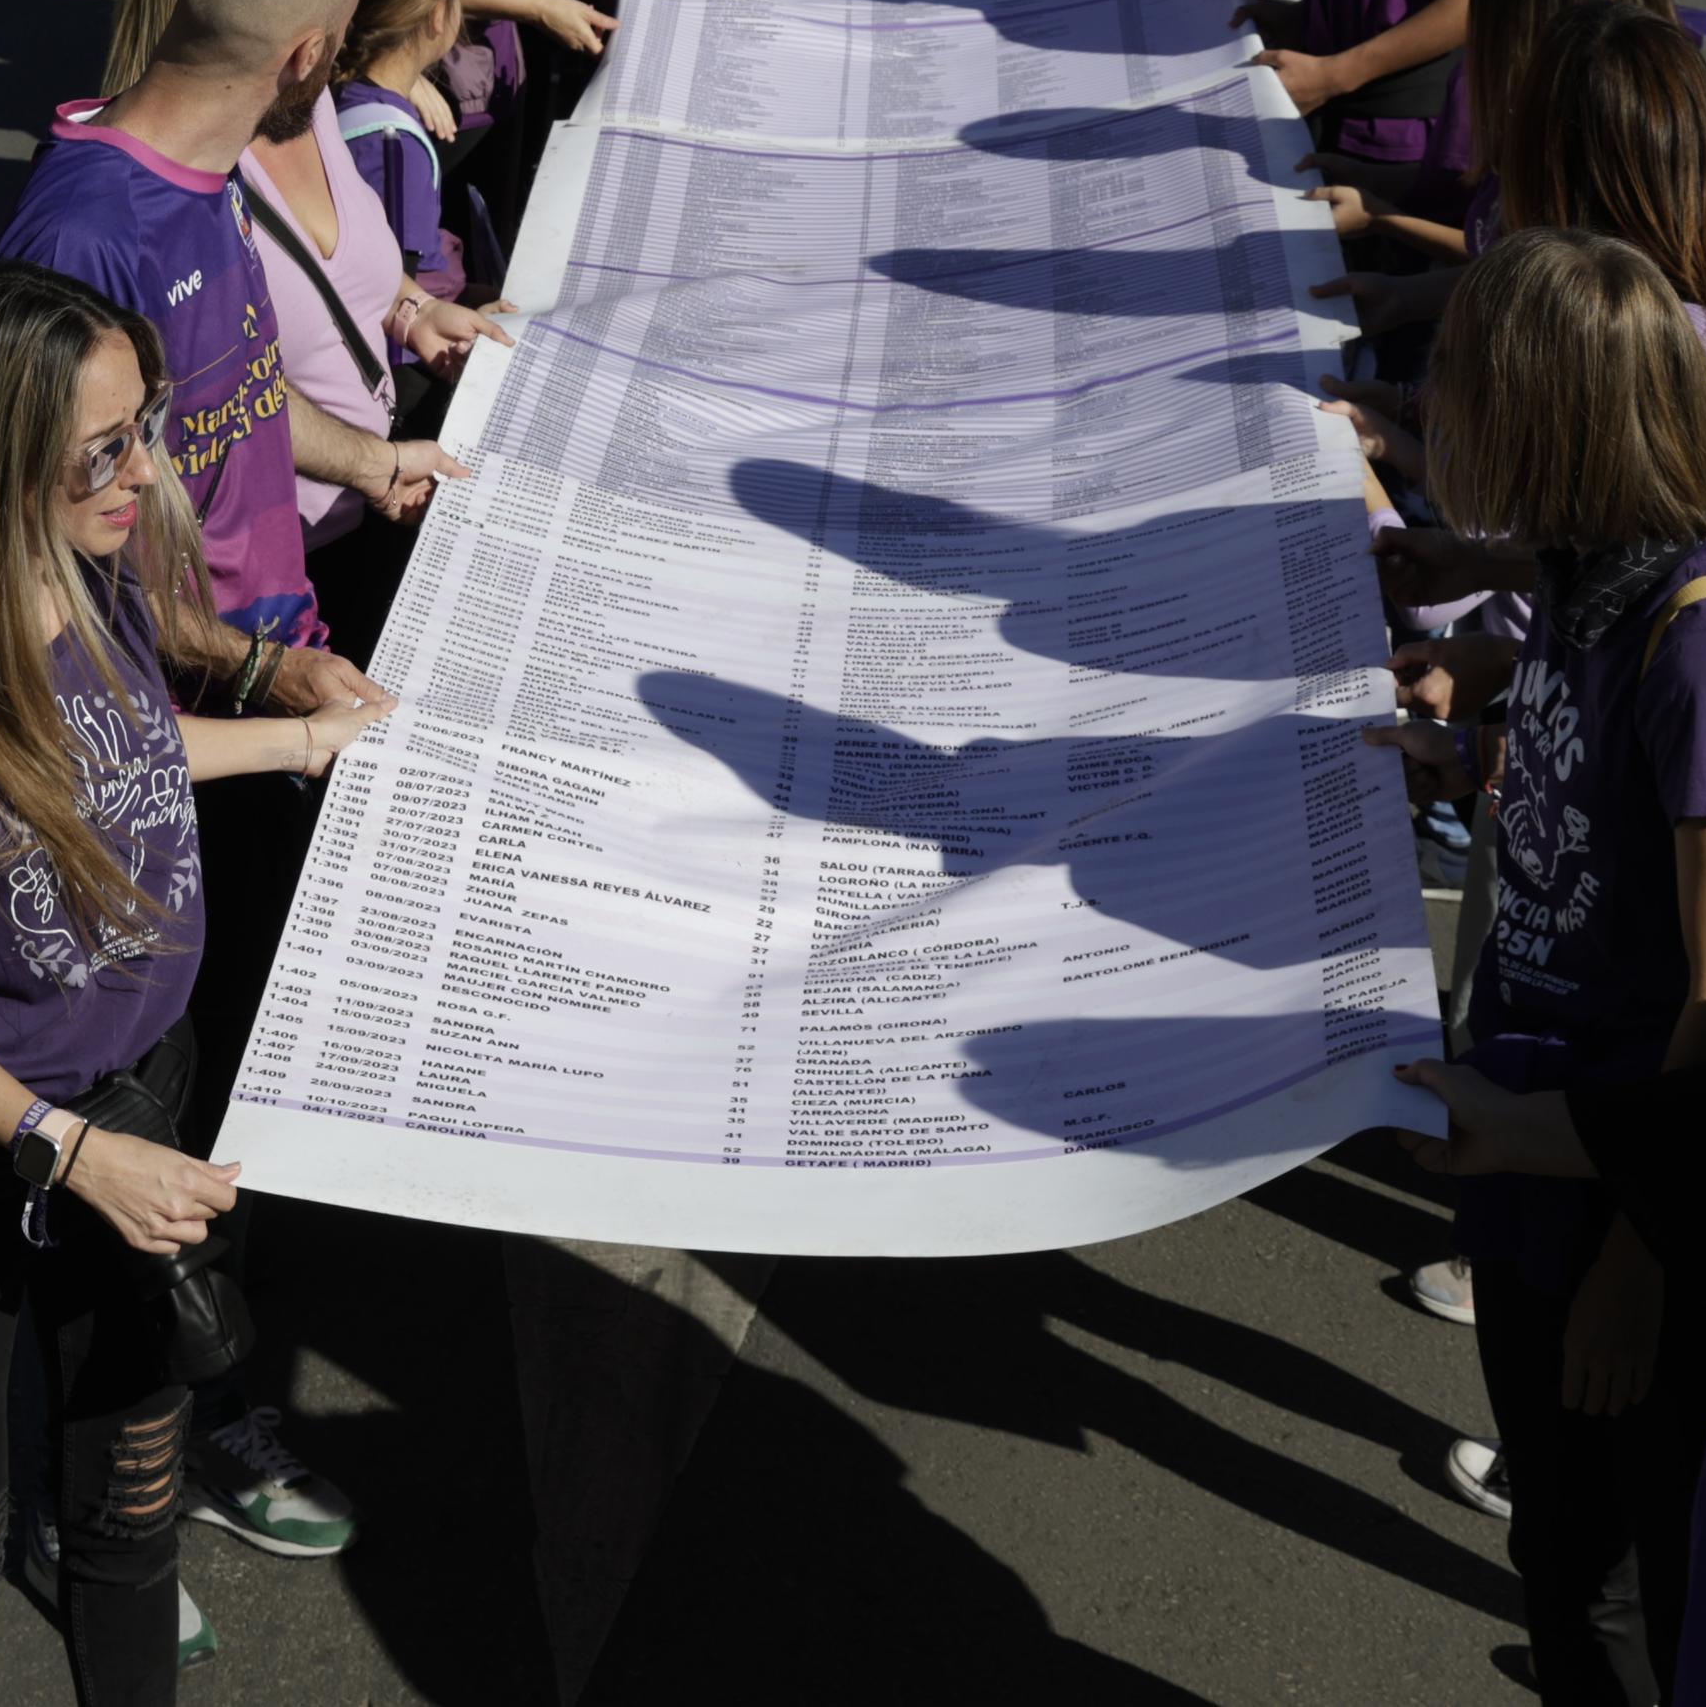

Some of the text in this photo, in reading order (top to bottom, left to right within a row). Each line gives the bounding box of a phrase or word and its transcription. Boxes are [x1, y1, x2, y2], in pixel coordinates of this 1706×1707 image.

[166, 268, 203, 308] vive
[437, 509, 485, 530] 2023
[474, 847, 523, 863] ELENA
[477, 833, 527, 849] CARLA
[468, 873, 516, 890] MARÍA
[819, 860, 869, 873] SALOU
[465, 884, 518, 903] ZHOUR
[471, 860, 712, 914] ERICA VANESSA REYES ÁLVAREZ
[459, 911, 533, 936] EVARISTA
[462, 896, 569, 927] JUANA ZEPAS
[1317, 911, 1376, 942] MARIDO
[454, 928, 563, 959] ENCARNACIÓN
[1061, 943, 1131, 964] ANTONIO
[1062, 932, 1253, 984] BARTOLOMÉ BERENGUER
[449, 951, 509, 971] RAQUEL
[595, 983, 647, 999] PARDO
[451, 939, 671, 993] ROSARIO MARTÍN CHAMORRO
[277, 963, 419, 1002] 1.402 05/09/2023
[443, 972, 611, 1014] MAUJER CON NOMBRE
[446, 961, 641, 1009] MARCIEL GARCÍA VALMEO
[1347, 977, 1409, 1001] PAREJA
[272, 981, 511, 1022] 1.403 11/09/2023 ROSA G.F.
[441, 983, 551, 1013] DESCONOCIDO
[801, 1007, 865, 1017] SEVILLA
[269, 992, 495, 1035] 1.404 15/09/2023 SANDRA
[740, 1017, 948, 1033] 71 PALAMÓS (GIRONA)
[263, 1009, 605, 1079] 1.405 15/09/2023 NICOLETA MARÍA LUPO
[429, 1027, 521, 1051] SUZAN ANN
[797, 1037, 896, 1047] VILLANUEVA
[899, 1034, 930, 1043] DEL
[933, 1024, 1024, 1040] ARZOBISPO
[254, 1037, 471, 1085] 1.407 17/09/2023 LAURA
[257, 1026, 487, 1077] 1.406 16/09/2023 HANANE
[795, 1057, 873, 1066] GRANADA
[251, 1049, 487, 1099] 1.408 24/09/2023 MIGUELA
[793, 1067, 875, 1076] ORIHUELA
[879, 1060, 968, 1075] (ALICANTE)
[793, 1077, 887, 1086] CASTELLÓN
[890, 1075, 911, 1083] DE
[915, 1073, 937, 1082] LA
[940, 1069, 994, 1081] PLANA
[245, 1065, 477, 1113] 1.409 28/09/2023 SANDRA
[791, 1099, 839, 1107] CIEZA
[843, 1096, 917, 1107] (MURCIA)
[1062, 1081, 1128, 1100] CARLOS
[236, 1092, 488, 1141] 1.411 04/11/2023 CAROLINA
[240, 1082, 525, 1135] 1.410 10/10/2023 PAQUI LOPERA
[788, 1118, 887, 1126] VILLAVERDE
[892, 1114, 966, 1126] (MADRID)
[789, 1108, 890, 1117] TARRAGONA
[785, 1149, 908, 1157] BENALMÁDENA
[913, 1144, 992, 1157] (MÁLAGA)
[1062, 1118, 1156, 1143] FRANCISCO
[786, 1139, 864, 1147] DOMINGO
[868, 1137, 944, 1148] (TOLEDO)
[787, 1122, 990, 1137] VAL DE SANTO DE SANTO
[720, 1157, 741, 1166] 39
[784, 1159, 849, 1169] GETAFE
[862, 1158, 933, 1169] MADRID)
[1063, 1138, 1123, 1155] DANIEL
